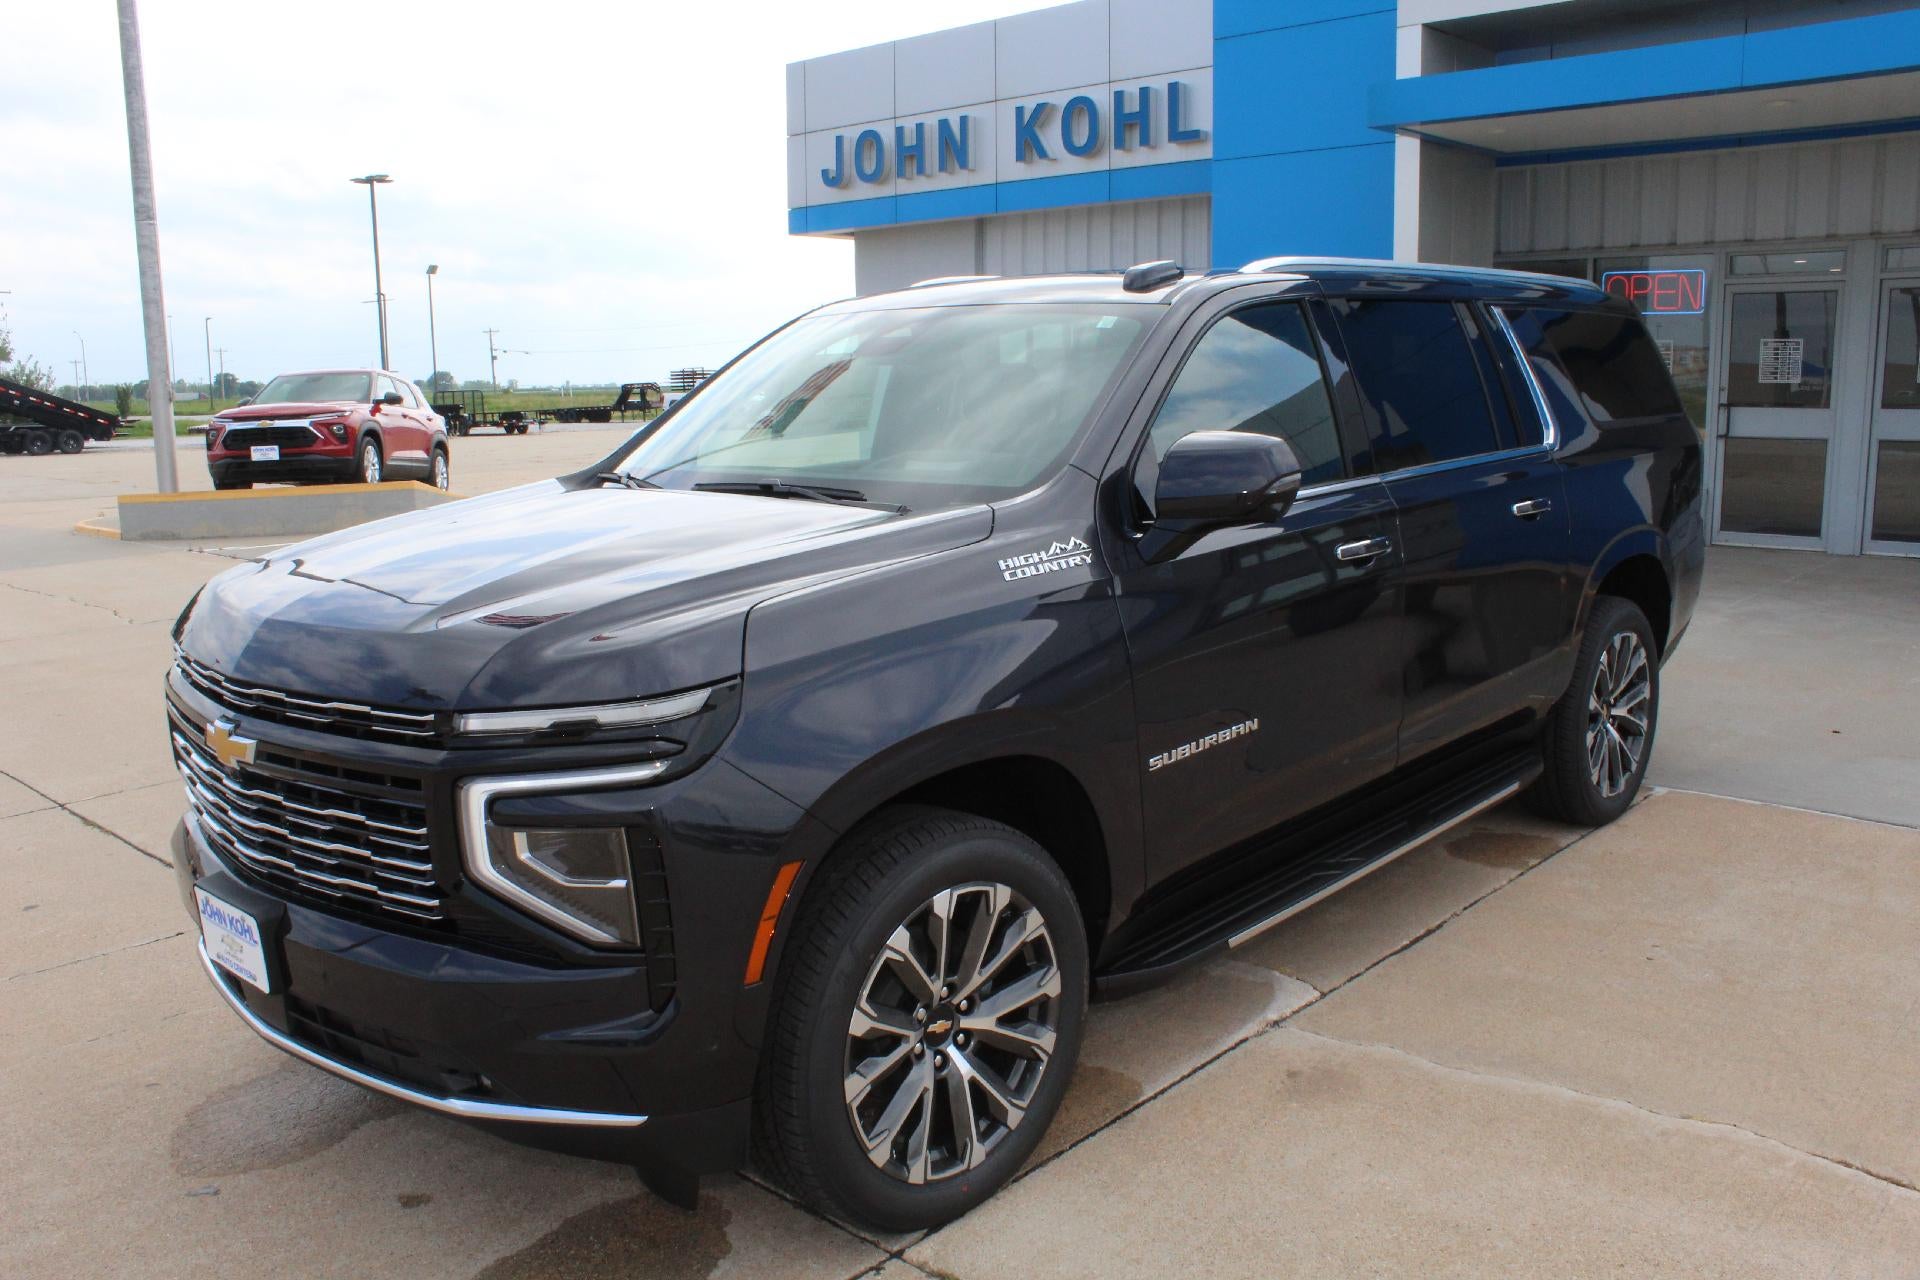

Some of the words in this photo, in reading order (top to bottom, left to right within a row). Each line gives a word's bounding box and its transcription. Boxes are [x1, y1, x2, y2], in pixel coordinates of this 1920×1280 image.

[821, 115, 975, 189] JOHN
[1015, 81, 1207, 163] KOHL
[1606, 272, 1702, 310] OPEN
[998, 550, 1047, 571] HIGH
[1003, 553, 1092, 582] COUNTRY
[1148, 718, 1259, 771] SUBURBAN
[200, 898, 227, 926] JOHN
[227, 912, 258, 945] KOHL
